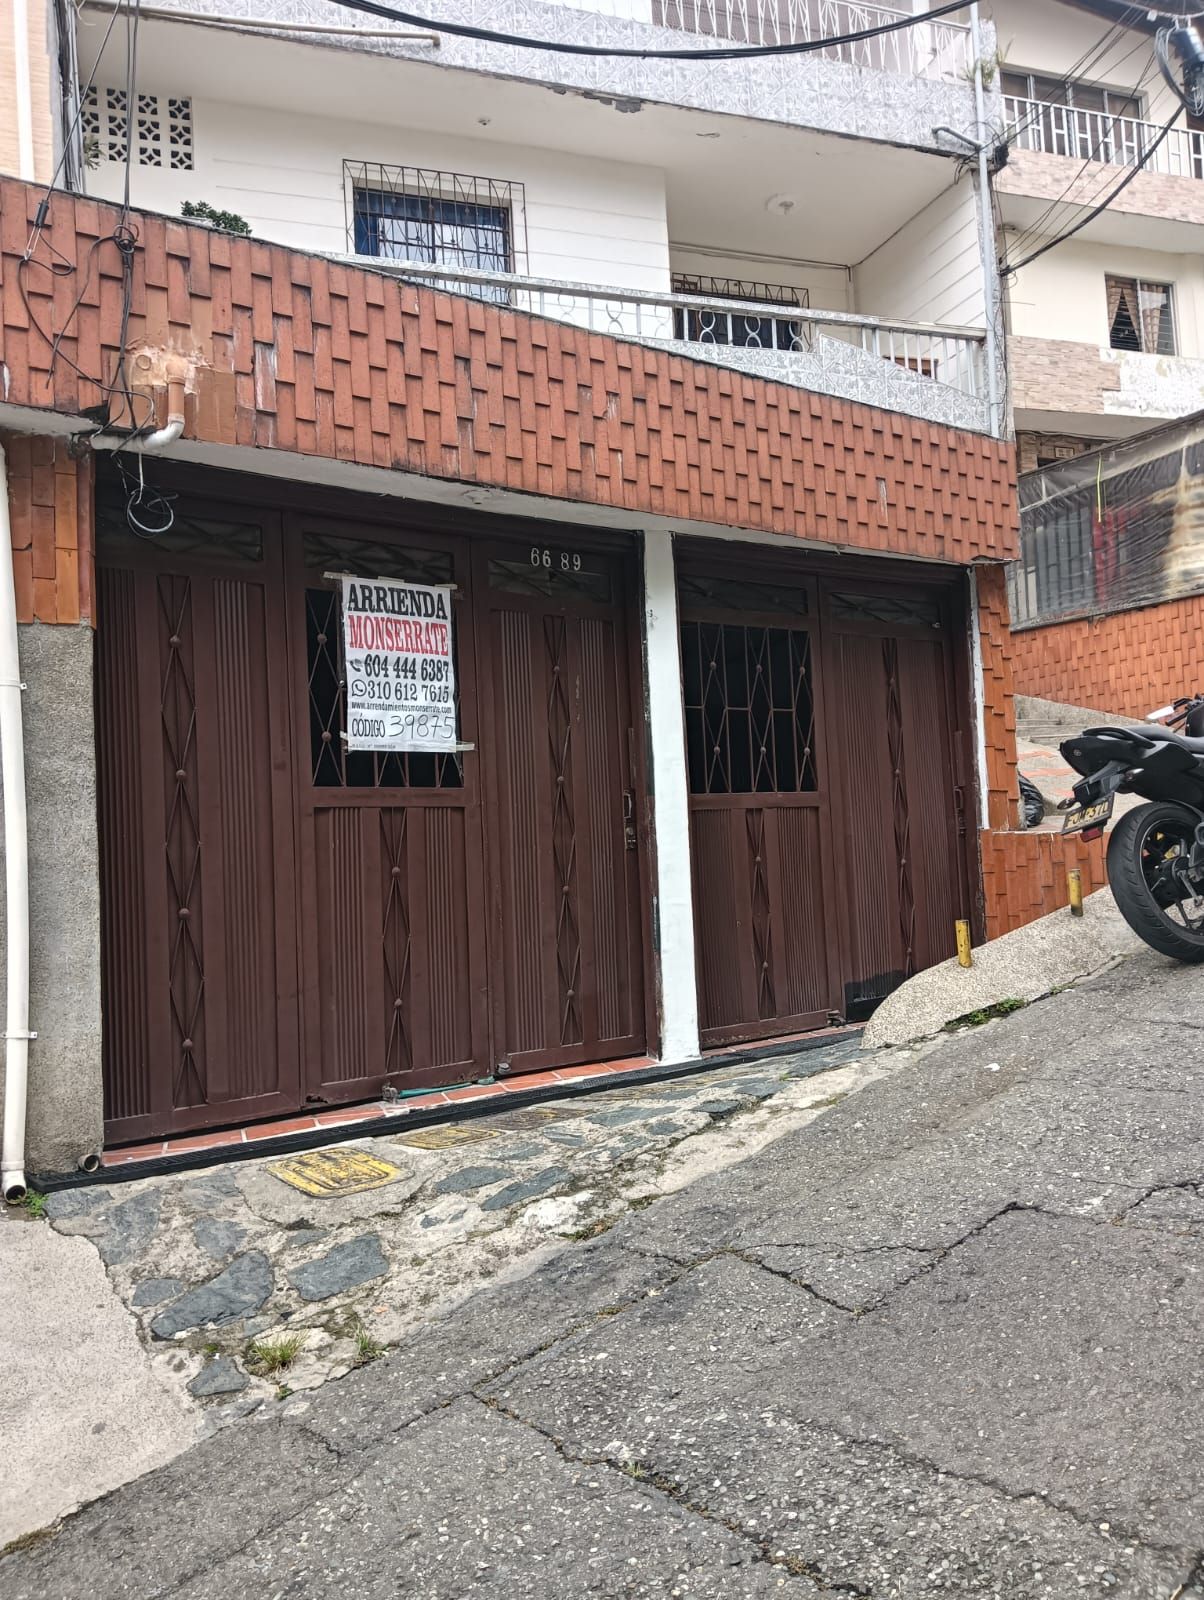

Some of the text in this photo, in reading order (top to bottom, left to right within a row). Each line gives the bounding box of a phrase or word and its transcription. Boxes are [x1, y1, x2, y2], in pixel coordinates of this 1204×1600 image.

[530, 547, 581, 571] 66 89
[347, 583, 449, 620] ARRIENDA
[347, 614, 449, 656] MONSERRATE
[364, 653, 449, 683] 604 444 6387
[367, 680, 449, 703] 310 612 7615
[351, 713, 456, 740] CÓDIGO 39875
